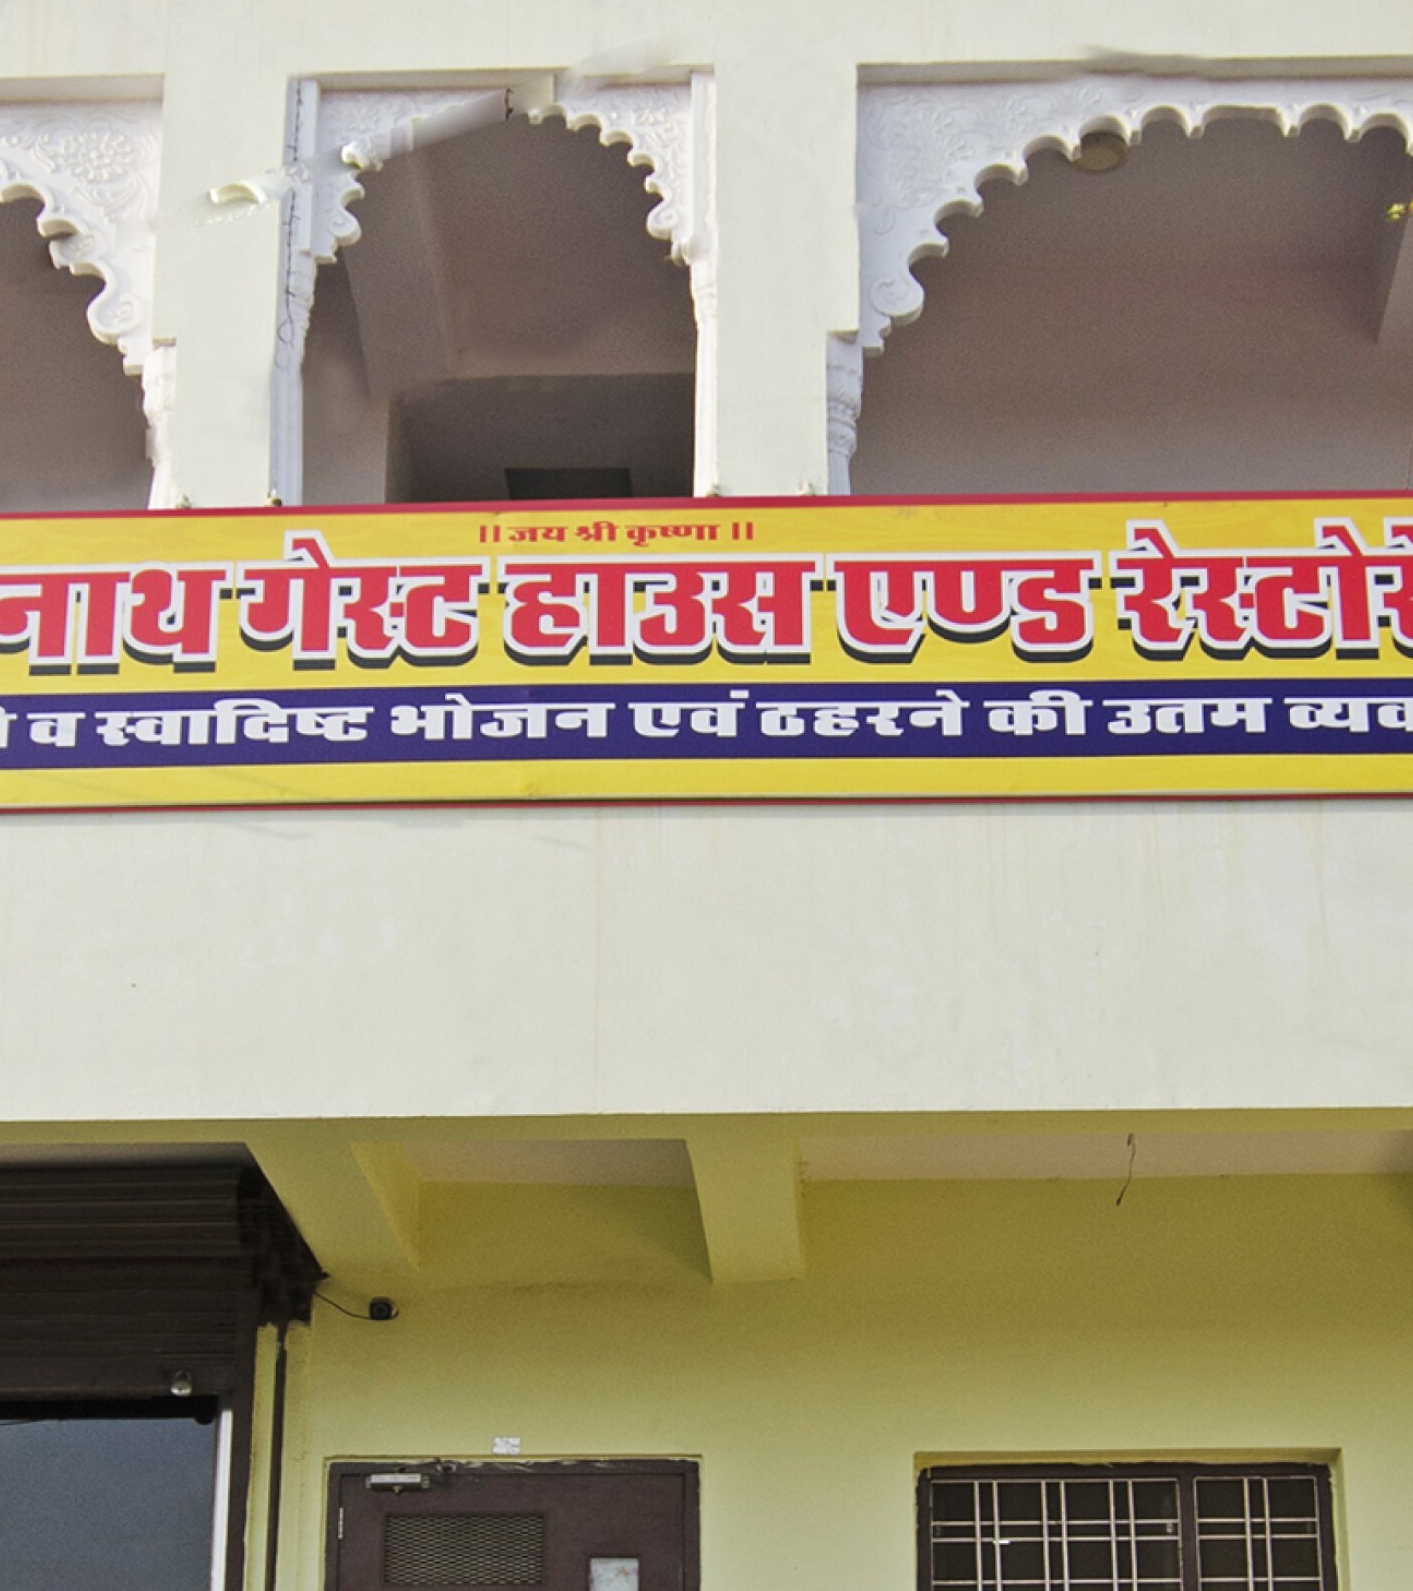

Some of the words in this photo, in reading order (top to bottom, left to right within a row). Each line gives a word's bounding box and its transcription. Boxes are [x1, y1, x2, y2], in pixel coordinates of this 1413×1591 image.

[507, 525, 569, 543] जय
[574, 520, 620, 542] श्री
[624, 523, 721, 547] कृष्णा
[236, 529, 492, 672] गेस्ट
[496, 552, 826, 666] हाउस
[824, 549, 1104, 664] एण्ड
[27, 711, 86, 748] व
[390, 693, 616, 742] भोजन
[627, 689, 749, 738] एवं
[983, 689, 1093, 736] की
